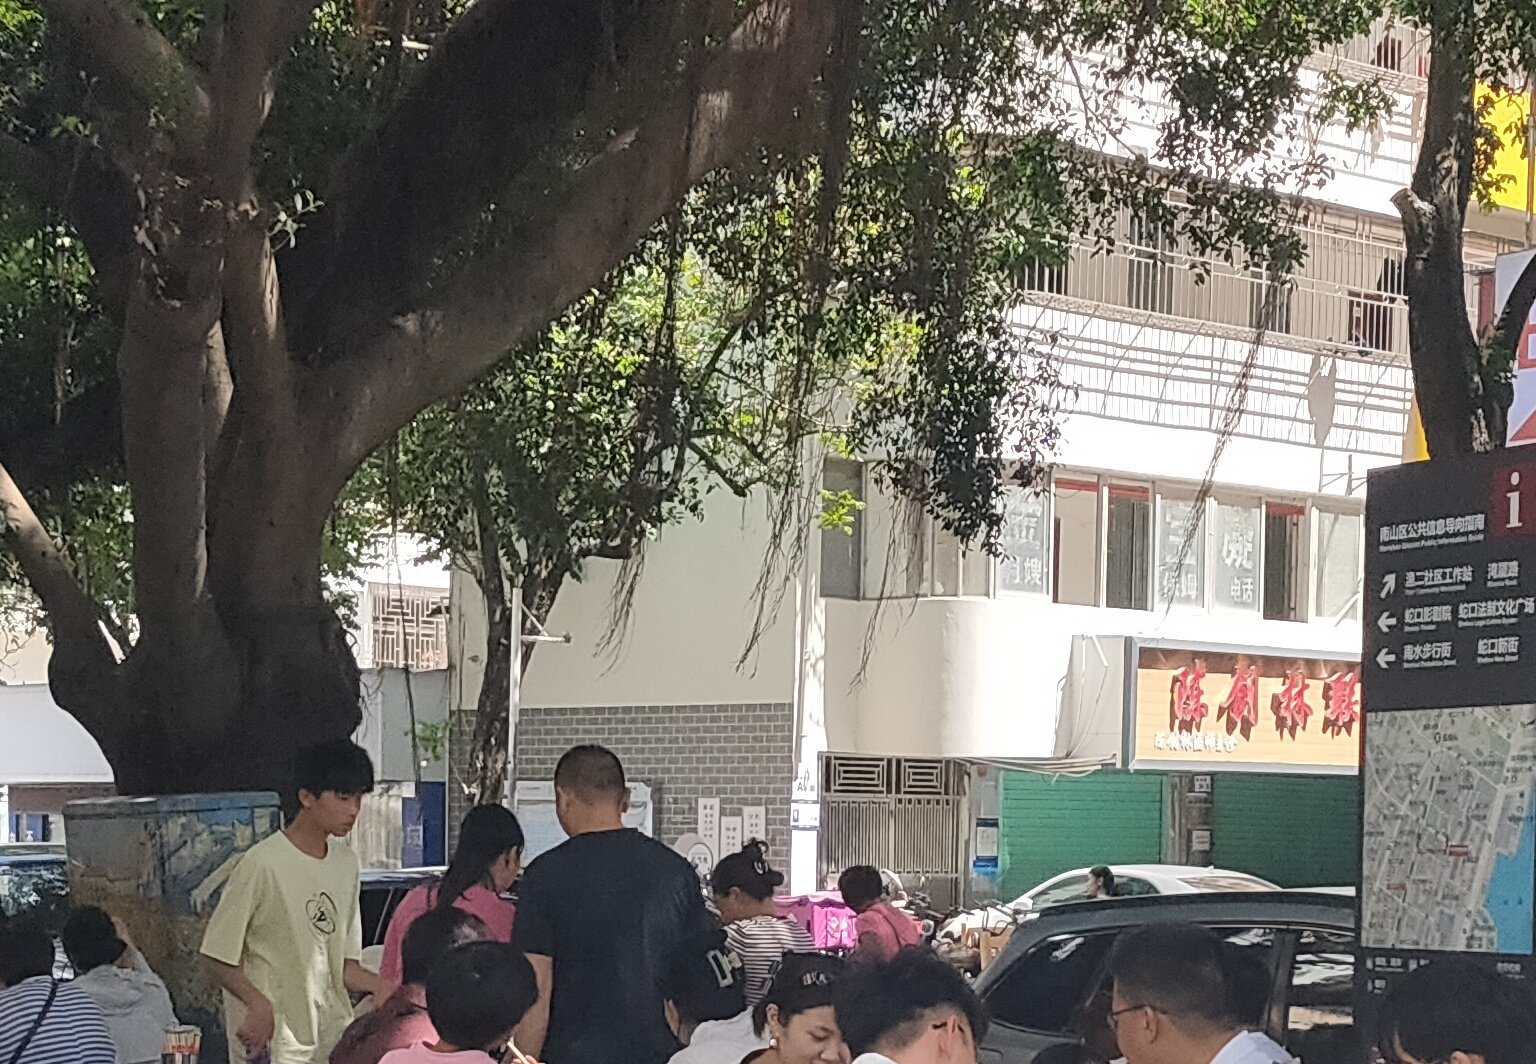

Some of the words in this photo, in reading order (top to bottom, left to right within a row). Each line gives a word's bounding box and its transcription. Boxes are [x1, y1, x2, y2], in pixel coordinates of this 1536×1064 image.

[1379, 513, 1485, 543] 南山区公共信息导向指南
